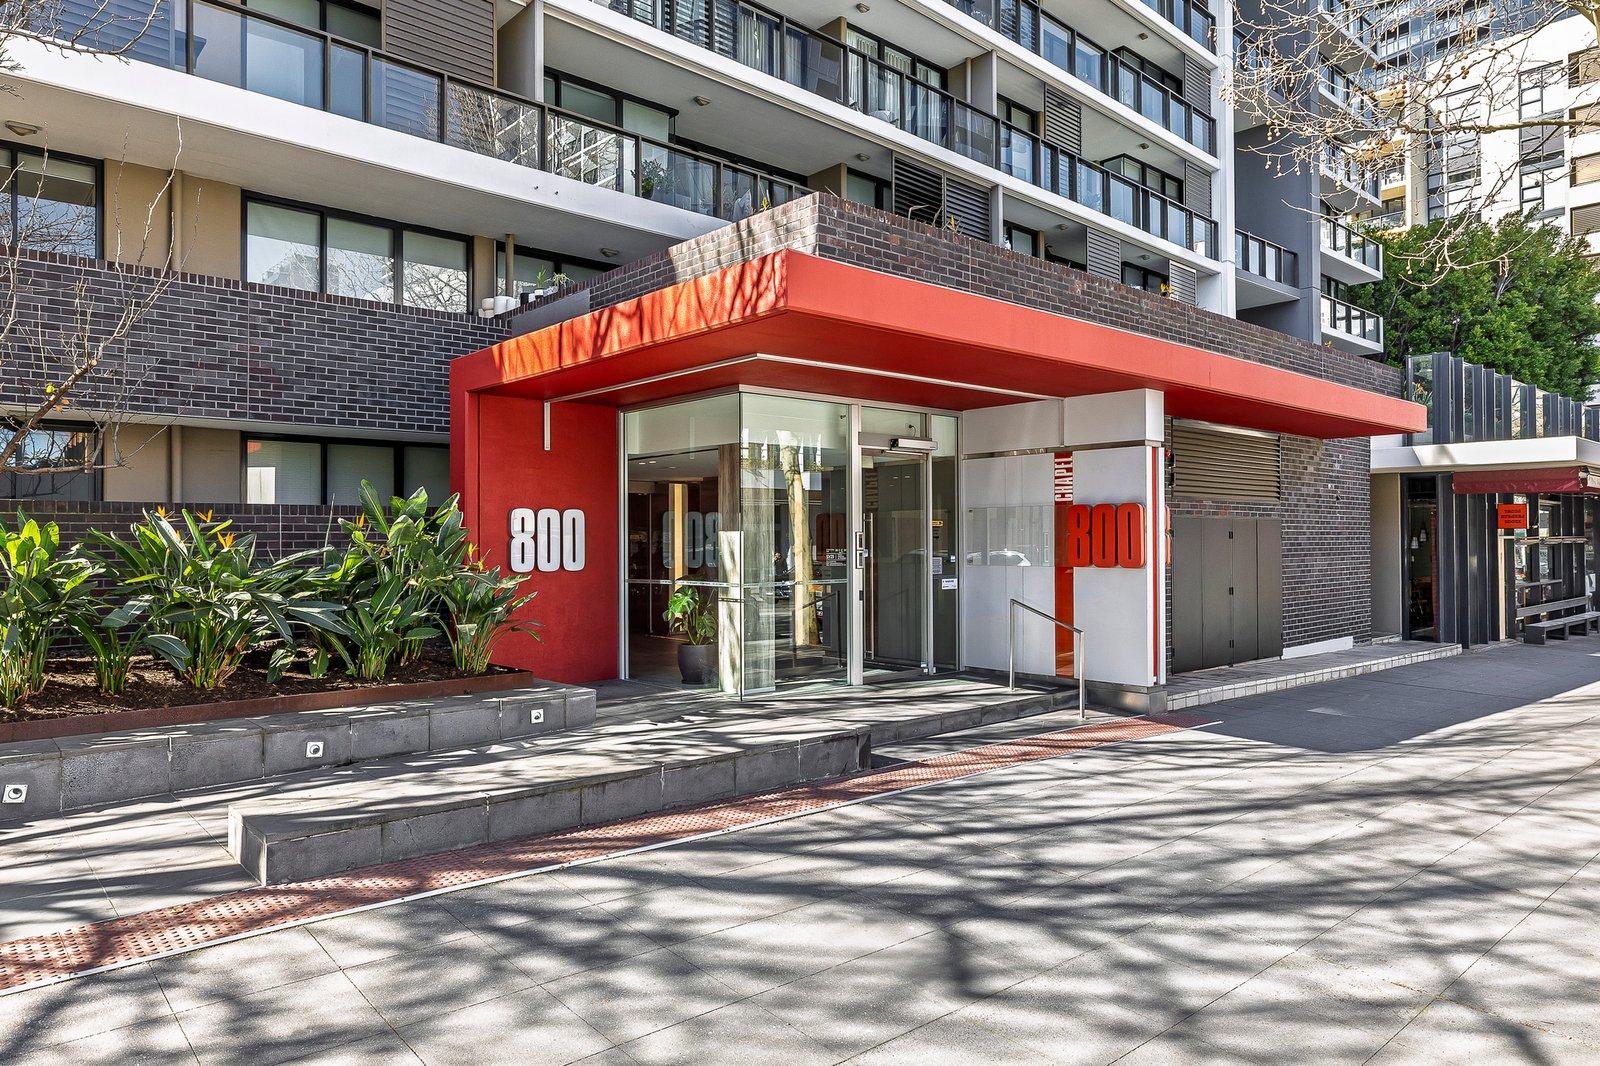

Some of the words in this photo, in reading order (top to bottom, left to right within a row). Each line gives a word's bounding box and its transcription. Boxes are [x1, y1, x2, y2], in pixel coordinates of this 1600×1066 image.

[1054, 456, 1073, 501] CHAPEL
[509, 508, 585, 572] 800
[1067, 502, 1146, 569] 800
